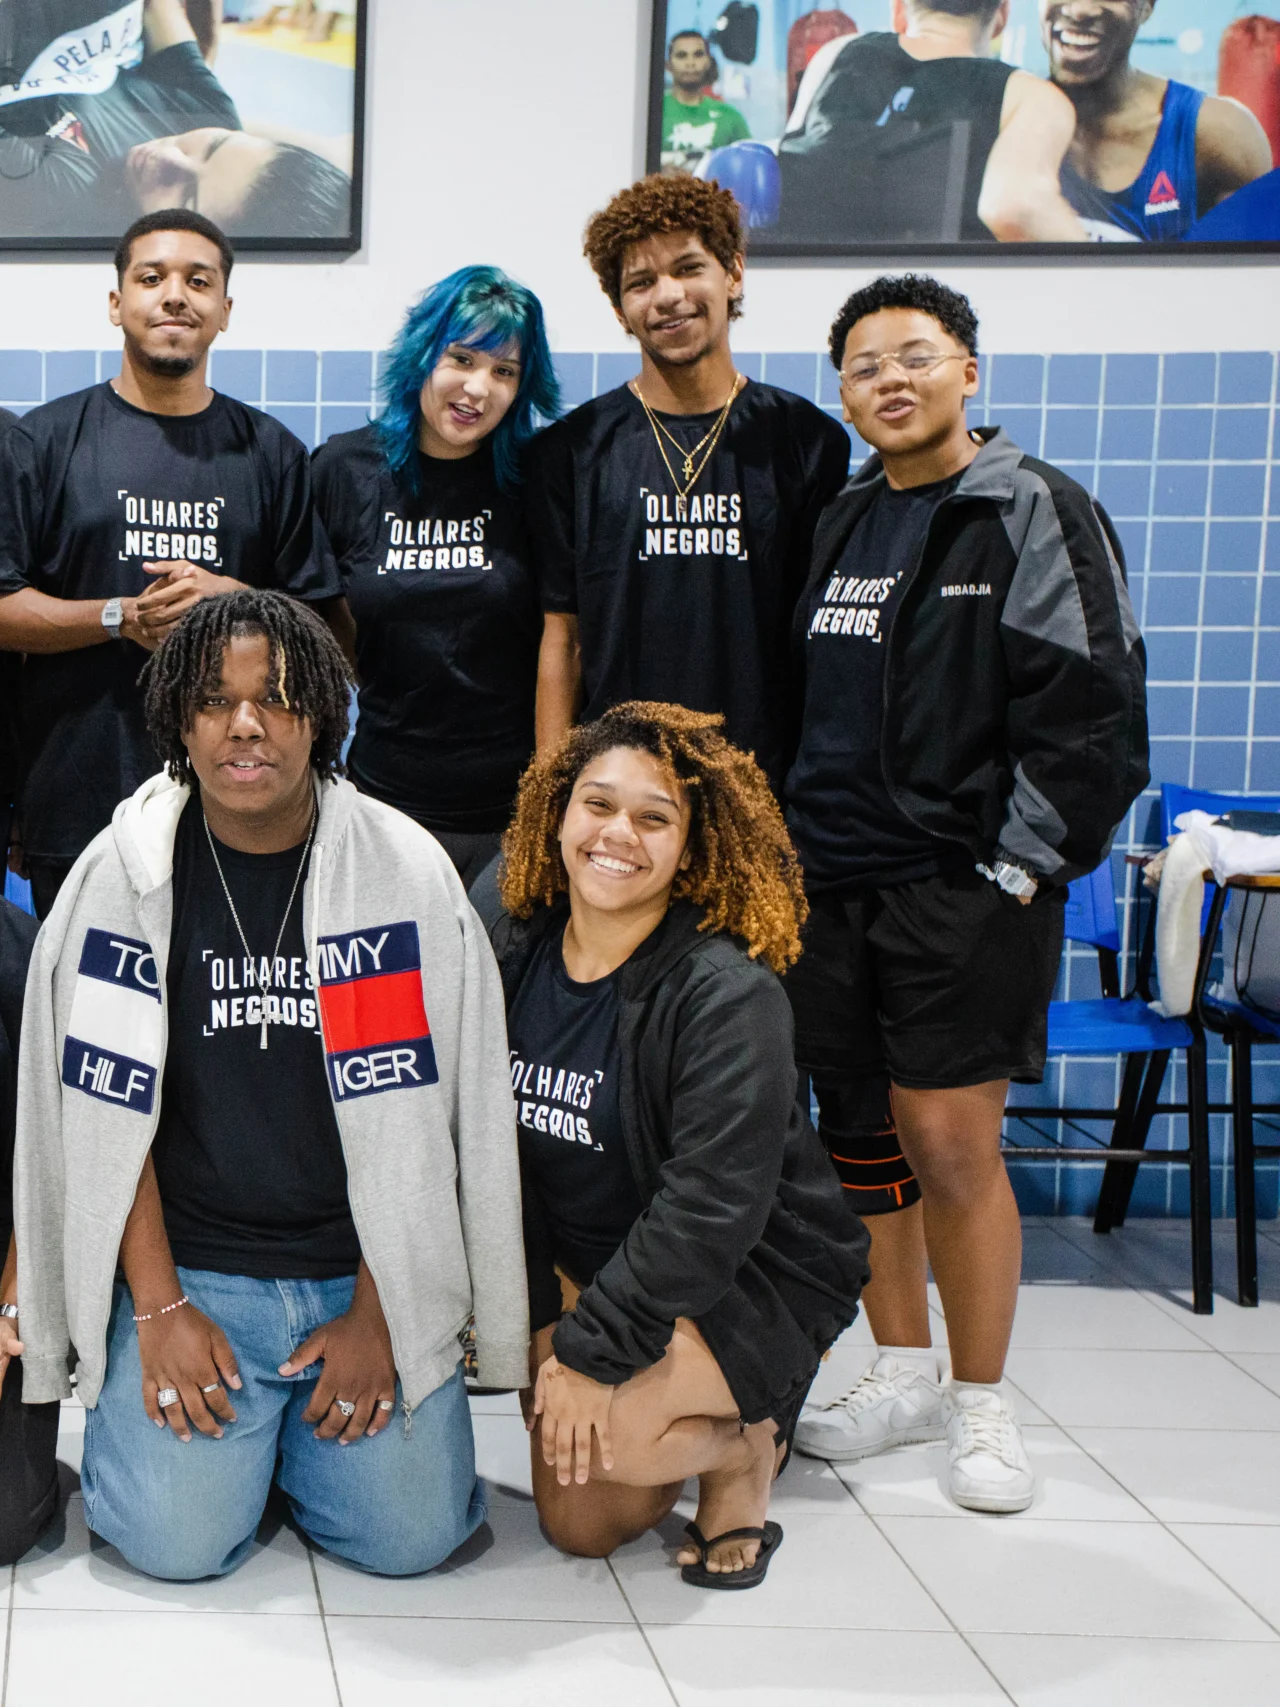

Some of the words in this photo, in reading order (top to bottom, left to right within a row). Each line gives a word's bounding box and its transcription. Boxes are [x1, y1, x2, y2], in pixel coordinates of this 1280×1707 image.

[53, 30, 111, 72] PELA
[125, 496, 219, 529] OLHARES
[646, 493, 741, 523] OLHARES
[125, 530, 217, 561] NEGROS
[390, 516, 485, 545] OLHARES
[645, 528, 740, 556] NEGROS
[385, 545, 484, 570] NEGROS
[824, 576, 895, 603] OLHARES
[810, 607, 881, 637] NEGROS
[211, 956, 315, 991] OLHARES
[211, 995, 317, 1029] NEGROS
[78, 1051, 150, 1102] HILF
[333, 1048, 422, 1096] IGER
[511, 1060, 595, 1110] OLHARES
[514, 1100, 593, 1145] EGROS
